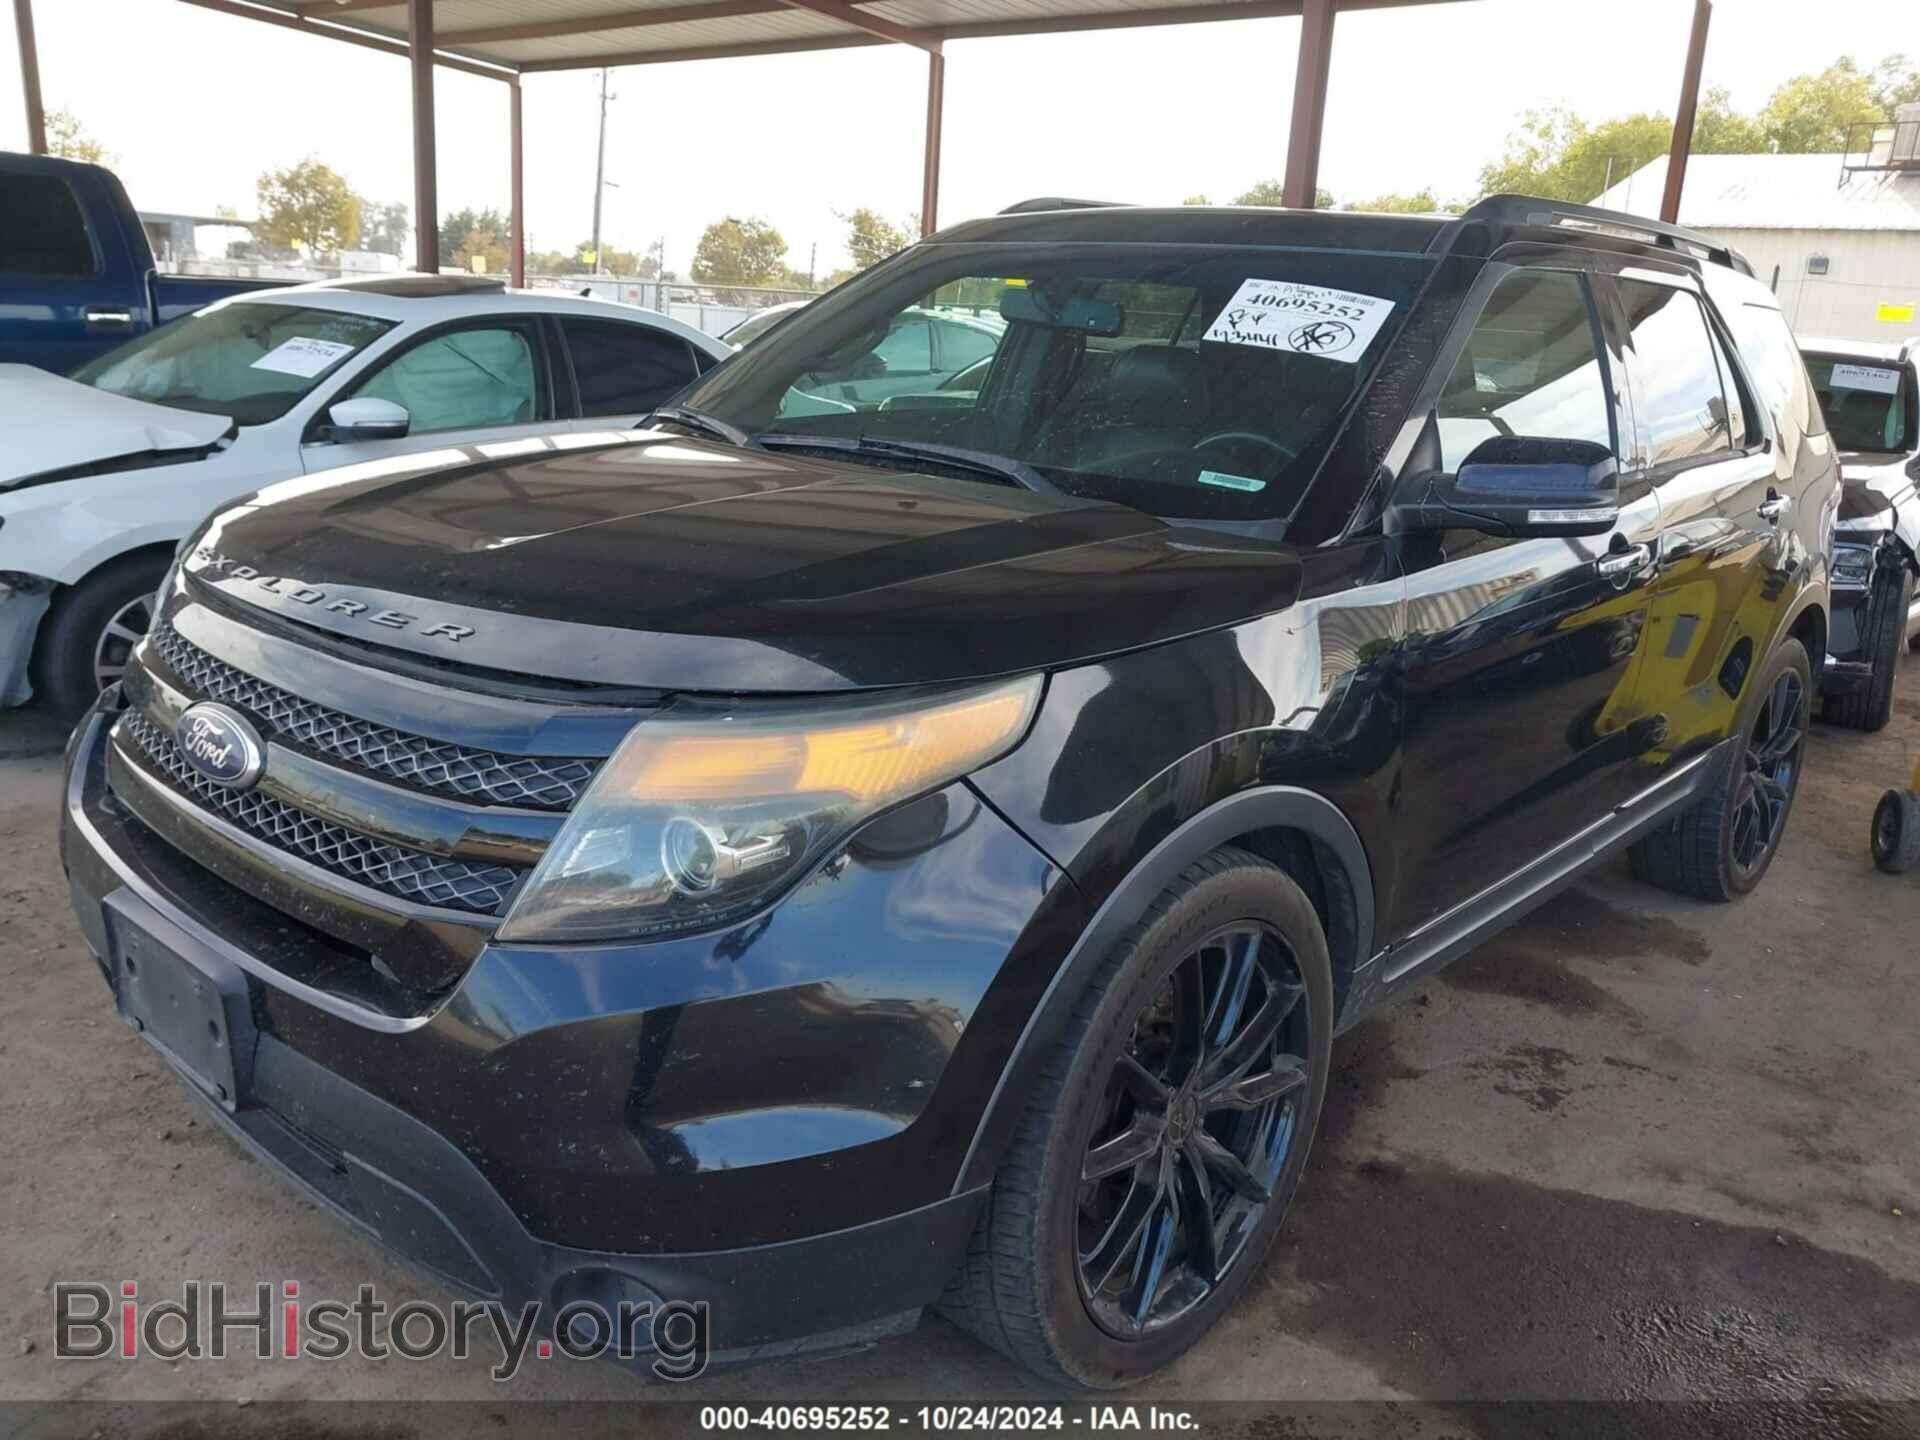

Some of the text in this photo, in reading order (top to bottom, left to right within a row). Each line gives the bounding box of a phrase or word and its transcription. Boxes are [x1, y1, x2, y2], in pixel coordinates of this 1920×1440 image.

[1246, 293, 1366, 321] 40695252
[196, 546, 476, 642] EXPLORER
[185, 716, 233, 769] Ford
